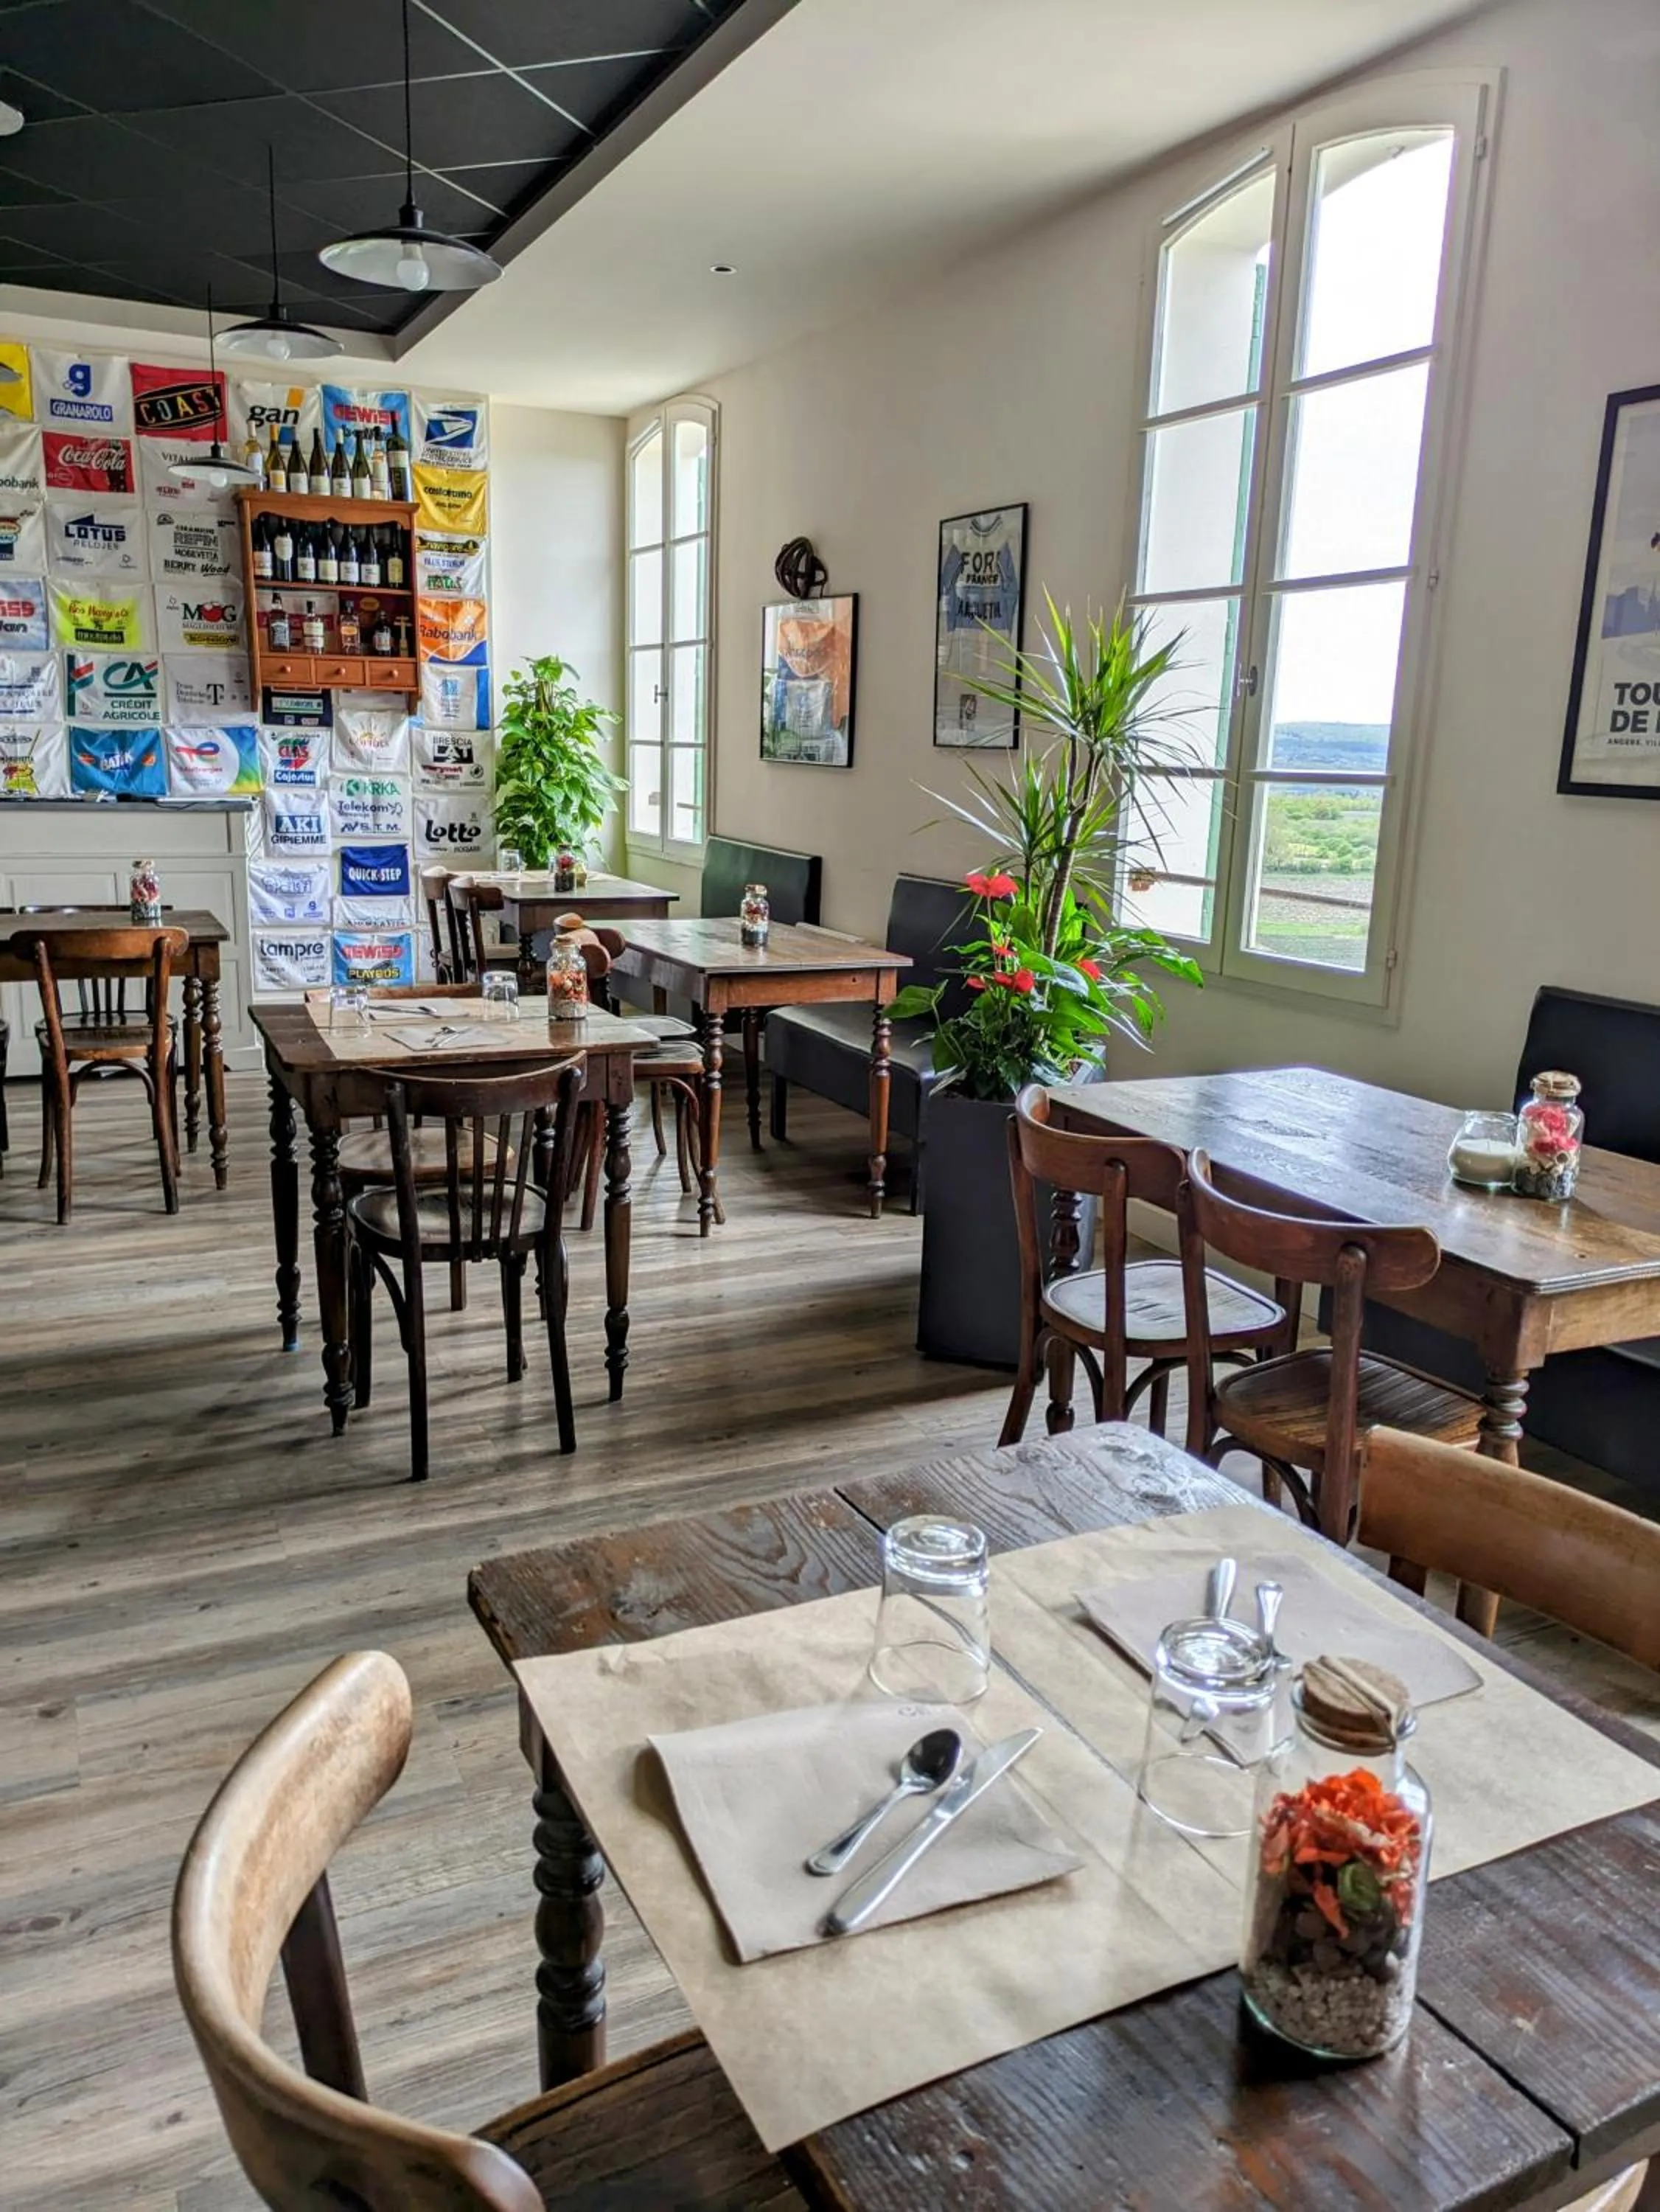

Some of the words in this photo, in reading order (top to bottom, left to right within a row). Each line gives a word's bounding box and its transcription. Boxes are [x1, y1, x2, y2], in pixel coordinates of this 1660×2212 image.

[52, 402, 111, 420] GRANAROLO
[246, 406, 299, 427] gan
[65, 525, 125, 541] LOTUS
[111, 700, 152, 709] CRÉDIT
[102, 711, 161, 720] AGRICOLE
[1610, 710, 1649, 733] DE
[433, 737, 472, 745] BRESCIA
[278, 745, 309, 759] CLAS
[363, 782, 402, 796] KRKA
[338, 801, 388, 813] Telekom
[279, 816, 319, 832] AKI
[271, 834, 326, 844] GIPIEMME
